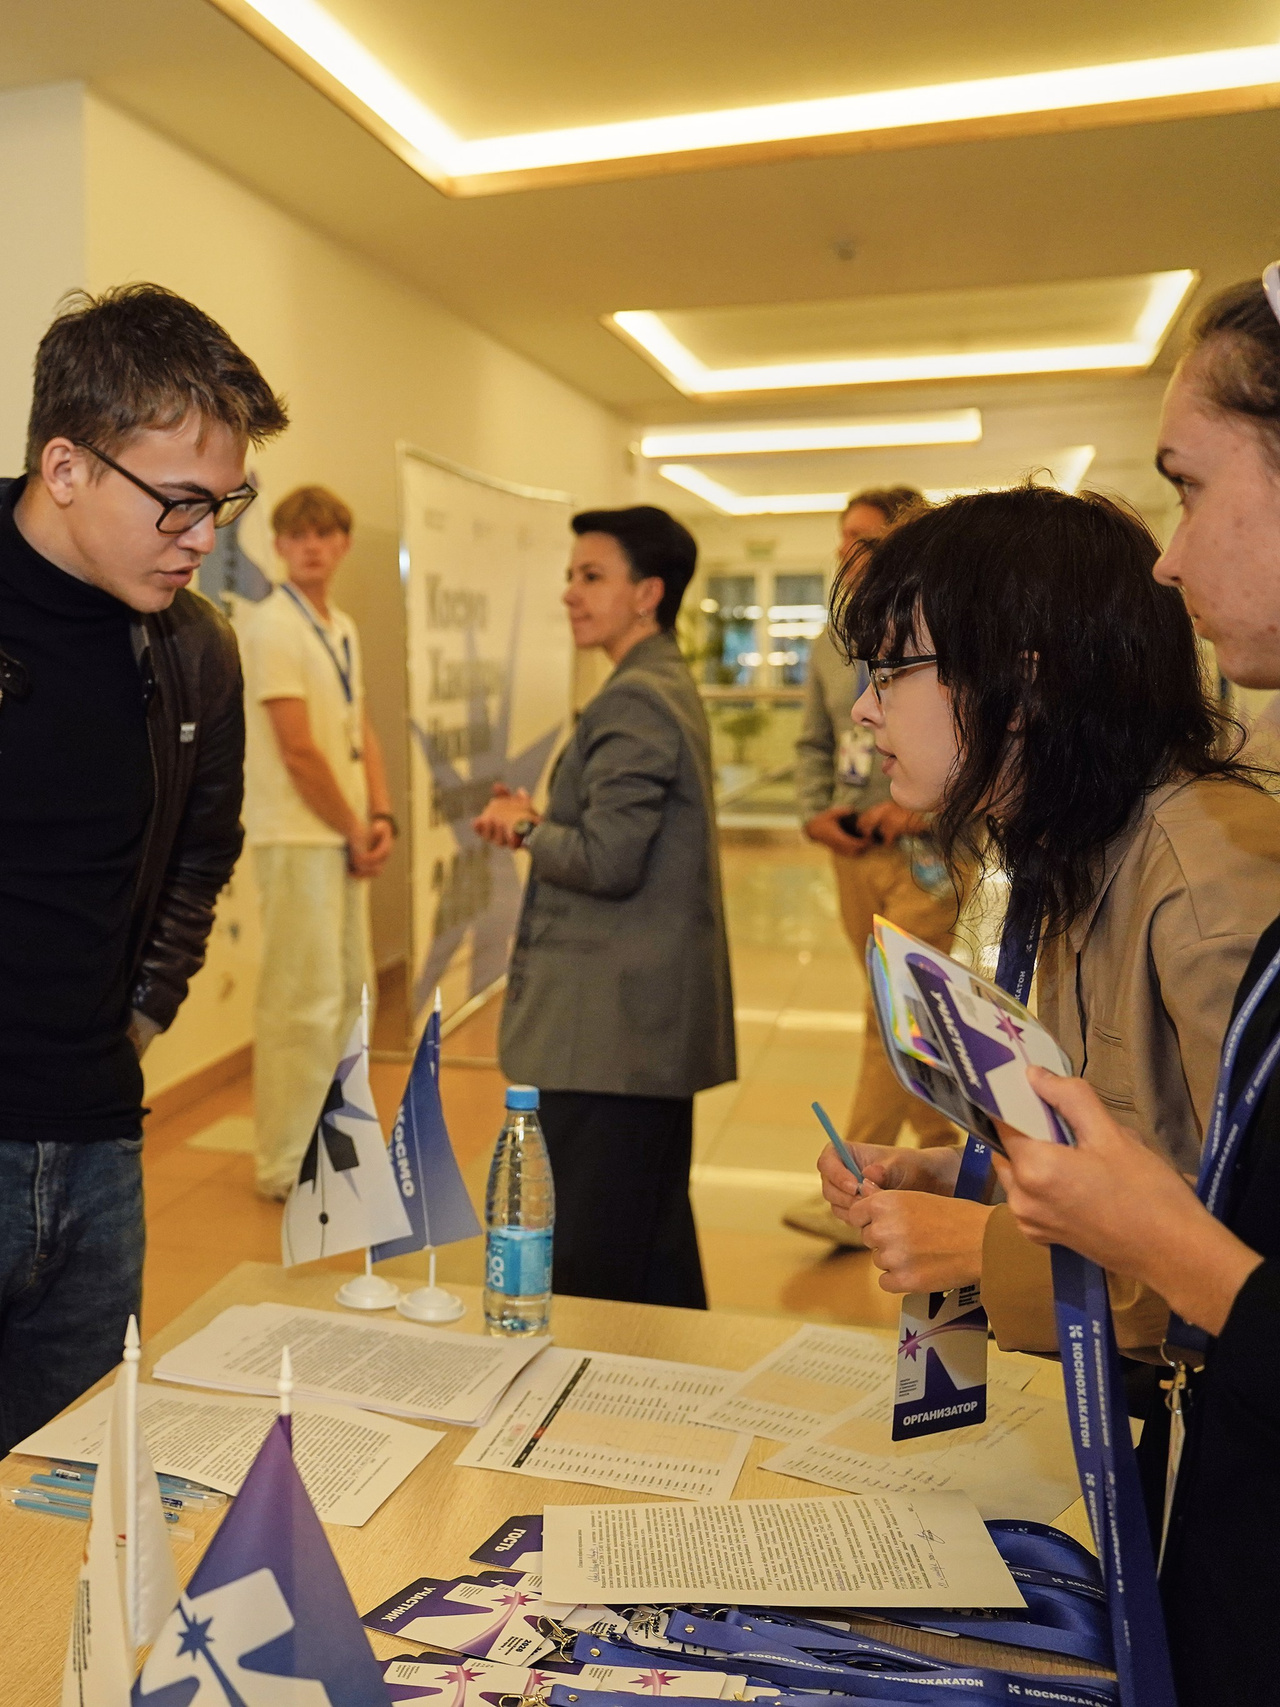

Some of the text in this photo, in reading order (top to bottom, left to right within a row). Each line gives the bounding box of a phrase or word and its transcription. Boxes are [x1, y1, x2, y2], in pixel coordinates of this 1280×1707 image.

[930, 990, 982, 1090] УЧАСТНИК
[1072, 1342, 1091, 1448] КОСМОХАКАТОН
[902, 1401, 978, 1426] ОРГАНИЗАТОР
[494, 1528, 527, 1552] ГОСТЬ
[381, 1586, 437, 1623] УЧАСТНИК
[749, 1653, 844, 1673] КОСМОХАКАТОН
[1025, 1688, 1109, 1707] КОСМОХАКА
